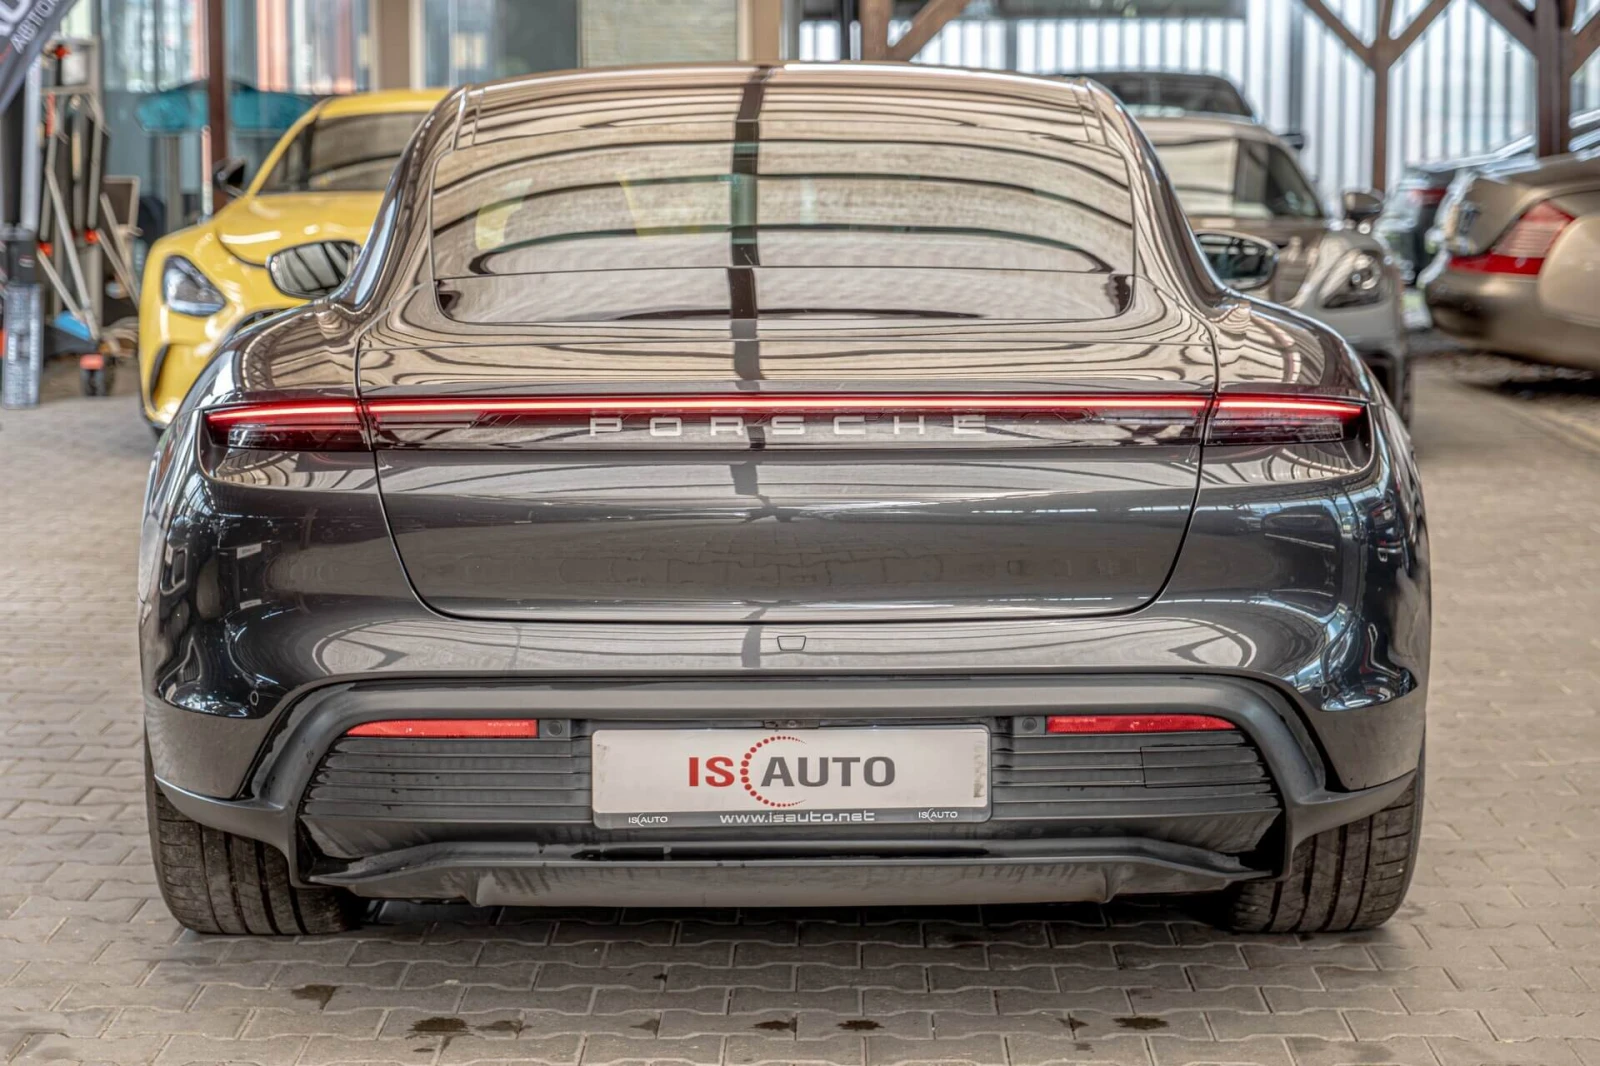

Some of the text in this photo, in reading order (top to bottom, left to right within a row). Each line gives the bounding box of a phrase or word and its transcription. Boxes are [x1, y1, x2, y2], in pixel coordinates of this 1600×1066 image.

[589, 415, 987, 436] PORSCHE
[761, 756, 895, 787] AUTO
[719, 810, 875, 824] www.isauto.net
